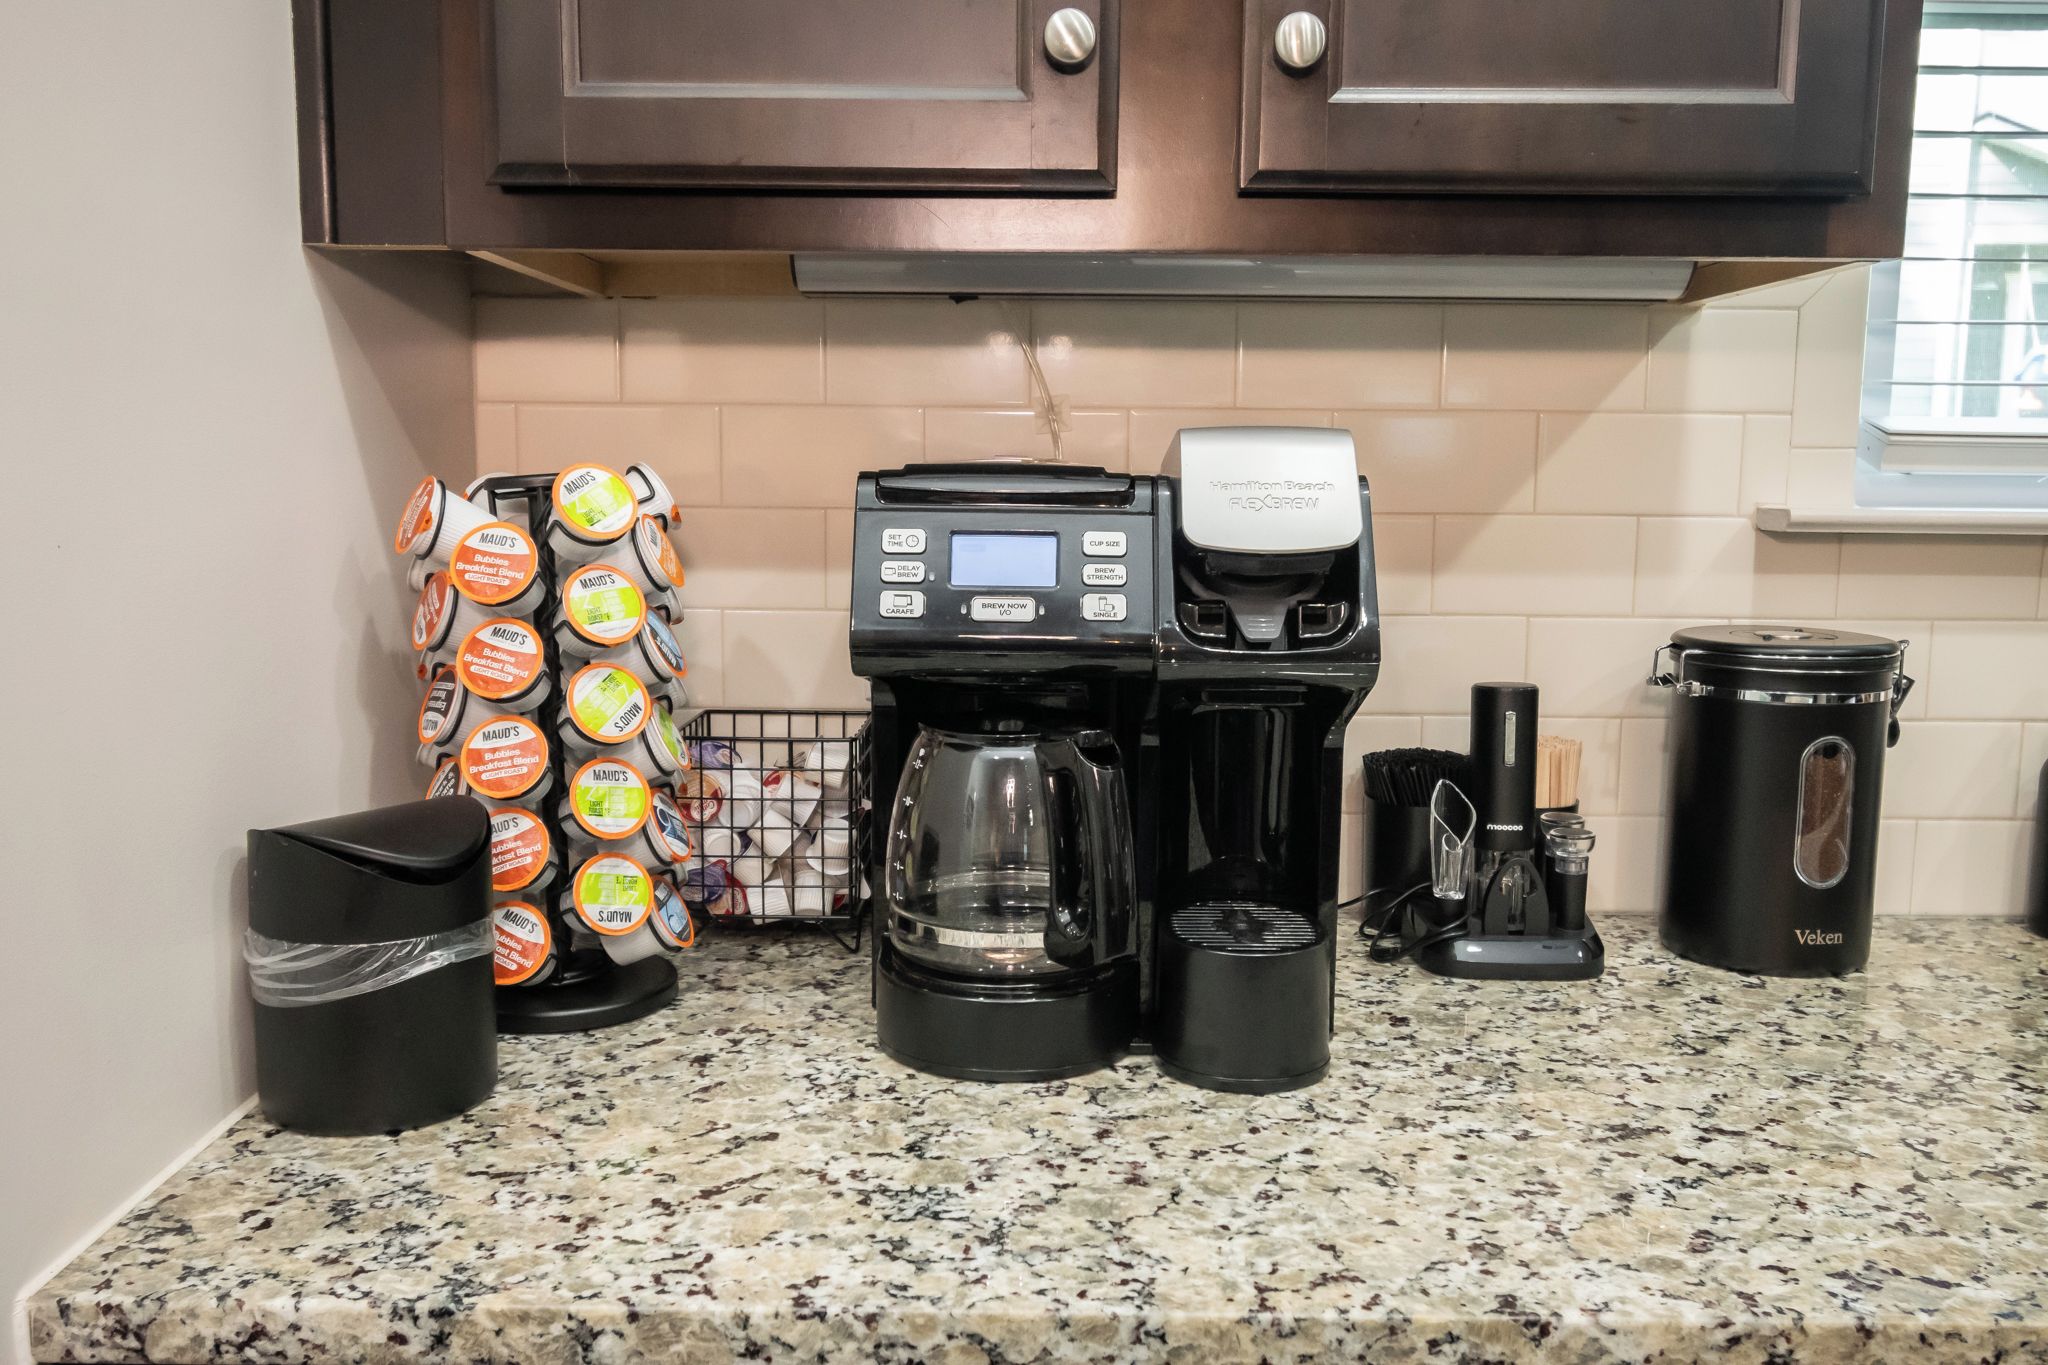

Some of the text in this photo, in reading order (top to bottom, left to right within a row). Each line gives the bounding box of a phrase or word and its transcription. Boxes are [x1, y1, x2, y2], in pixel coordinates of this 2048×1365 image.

[563, 471, 596, 495] MAUD'S
[1209, 480, 1335, 491] Hamilton Beach
[479, 532, 518, 548] MAUD'S
[474, 554, 510, 566] Bubbles
[456, 562, 524, 579] Breakfast Blend
[579, 573, 616, 590] MAUD'S
[490, 626, 528, 645] MAUD'S
[483, 648, 516, 663] Bubbles
[464, 653, 528, 678] Breakfast Blend
[614, 702, 642, 732] MAUD'S
[482, 726, 520, 742] MAUD'S
[485, 748, 520, 760] Bubbles
[469, 756, 539, 774] Breakfast Blend
[592, 769, 629, 782] MAUD'S
[491, 817, 519, 834] AUD'S
[492, 841, 523, 855] ubbles
[516, 843, 542, 857] Blend
[501, 909, 538, 934] MAUD'S
[598, 910, 633, 923] MAUD'S
[1794, 929, 1844, 945] Veken
[509, 951, 534, 968] Blend
